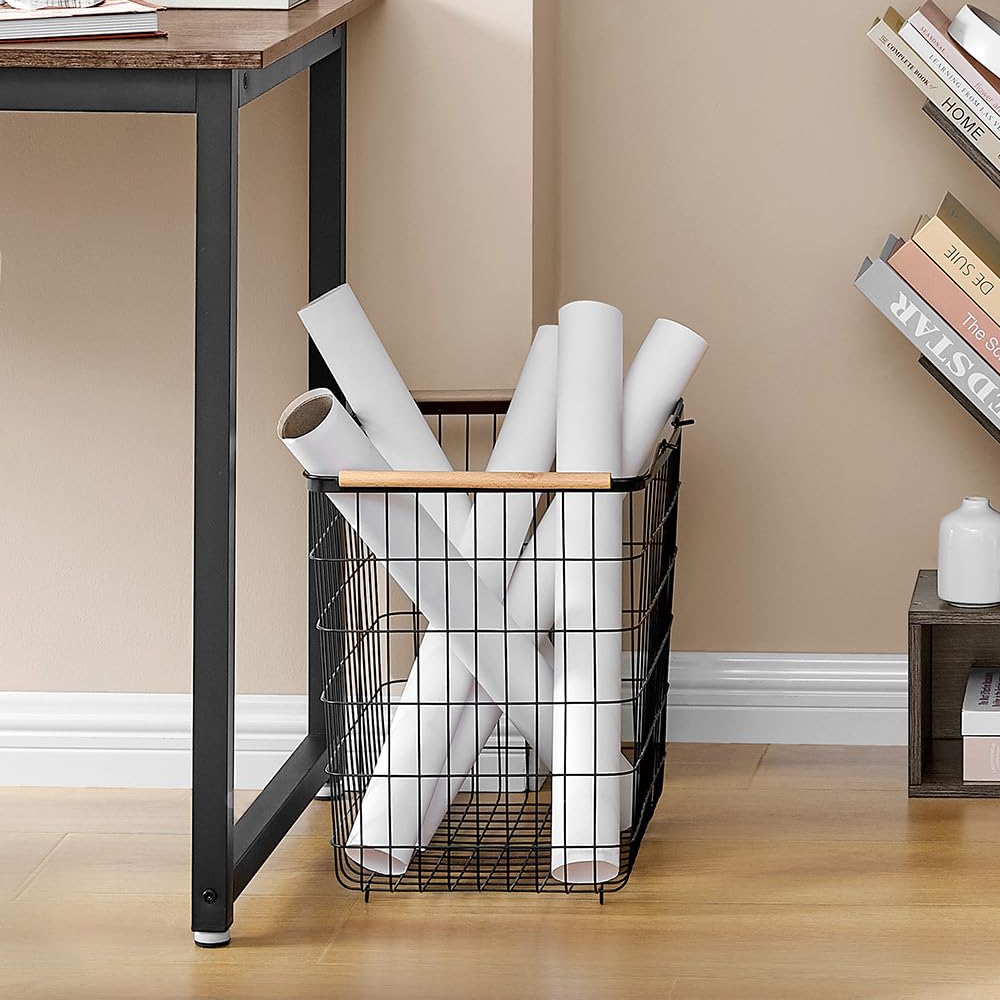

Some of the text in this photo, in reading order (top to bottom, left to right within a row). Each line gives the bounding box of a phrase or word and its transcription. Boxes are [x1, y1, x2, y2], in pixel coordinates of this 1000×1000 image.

[920, 26, 946, 53] SEASONAL
[886, 43, 914, 70] COMPLETE
[913, 69, 929, 86] BOOK
[928, 54, 962, 88] LEARNING
[961, 88, 980, 107] FROM
[979, 107, 993, 121] LAS
[972, 82, 994, 104] flower
[941, 97, 985, 141] HOME
[943, 245, 975, 276] SUIE
[971, 272, 994, 295] DE
[961, 312, 986, 340] The
